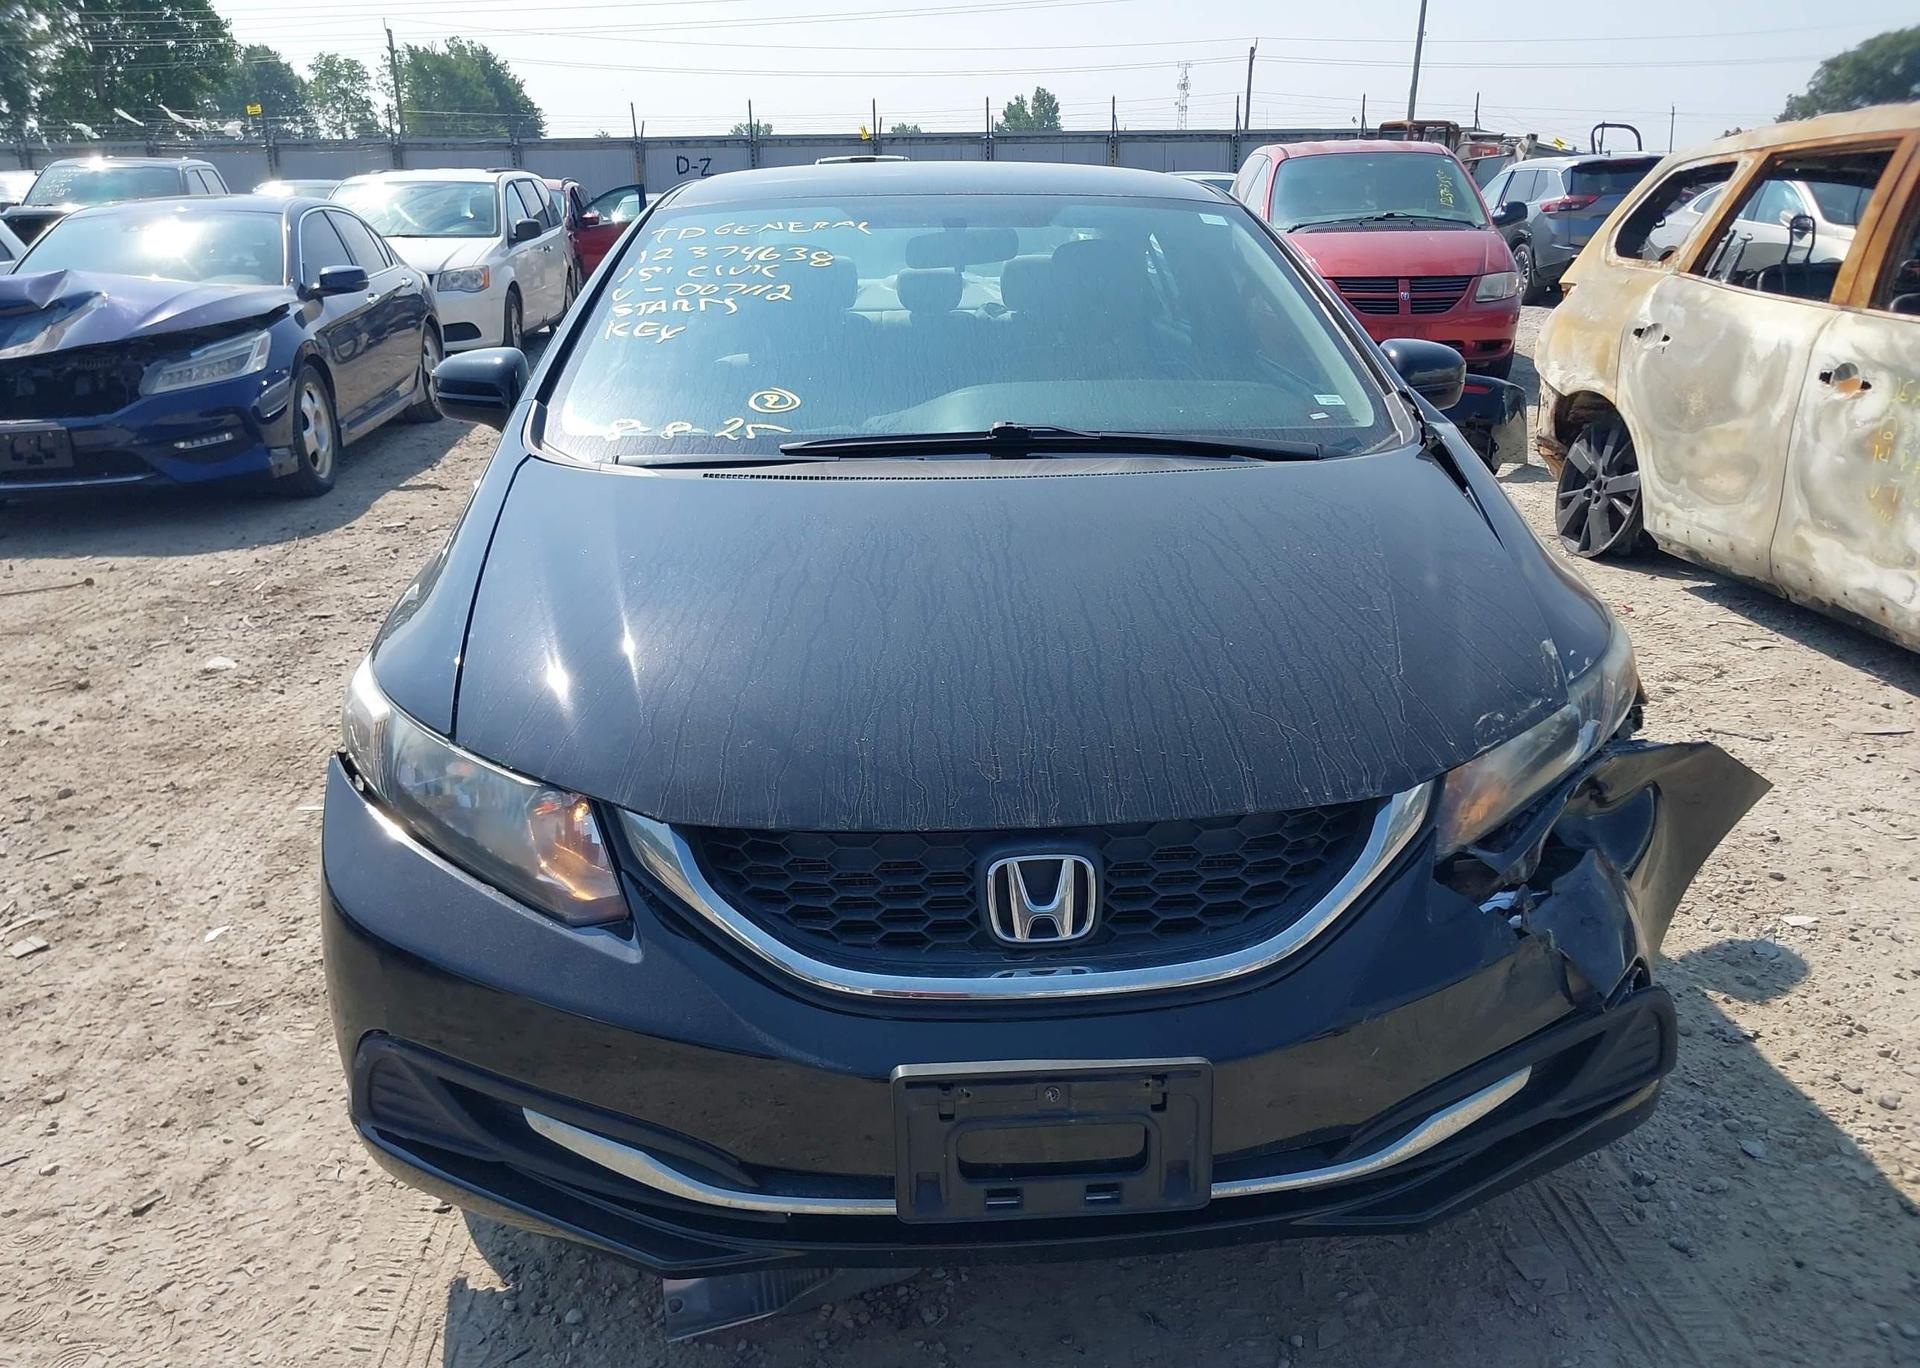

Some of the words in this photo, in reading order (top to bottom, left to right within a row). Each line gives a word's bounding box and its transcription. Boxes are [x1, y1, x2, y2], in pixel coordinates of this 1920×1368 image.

[714, 220, 872, 236] GENERAL
[612, 297, 738, 317] STARTS
[604, 319, 687, 344] KEY
[1006, 858, 1075, 941] H
